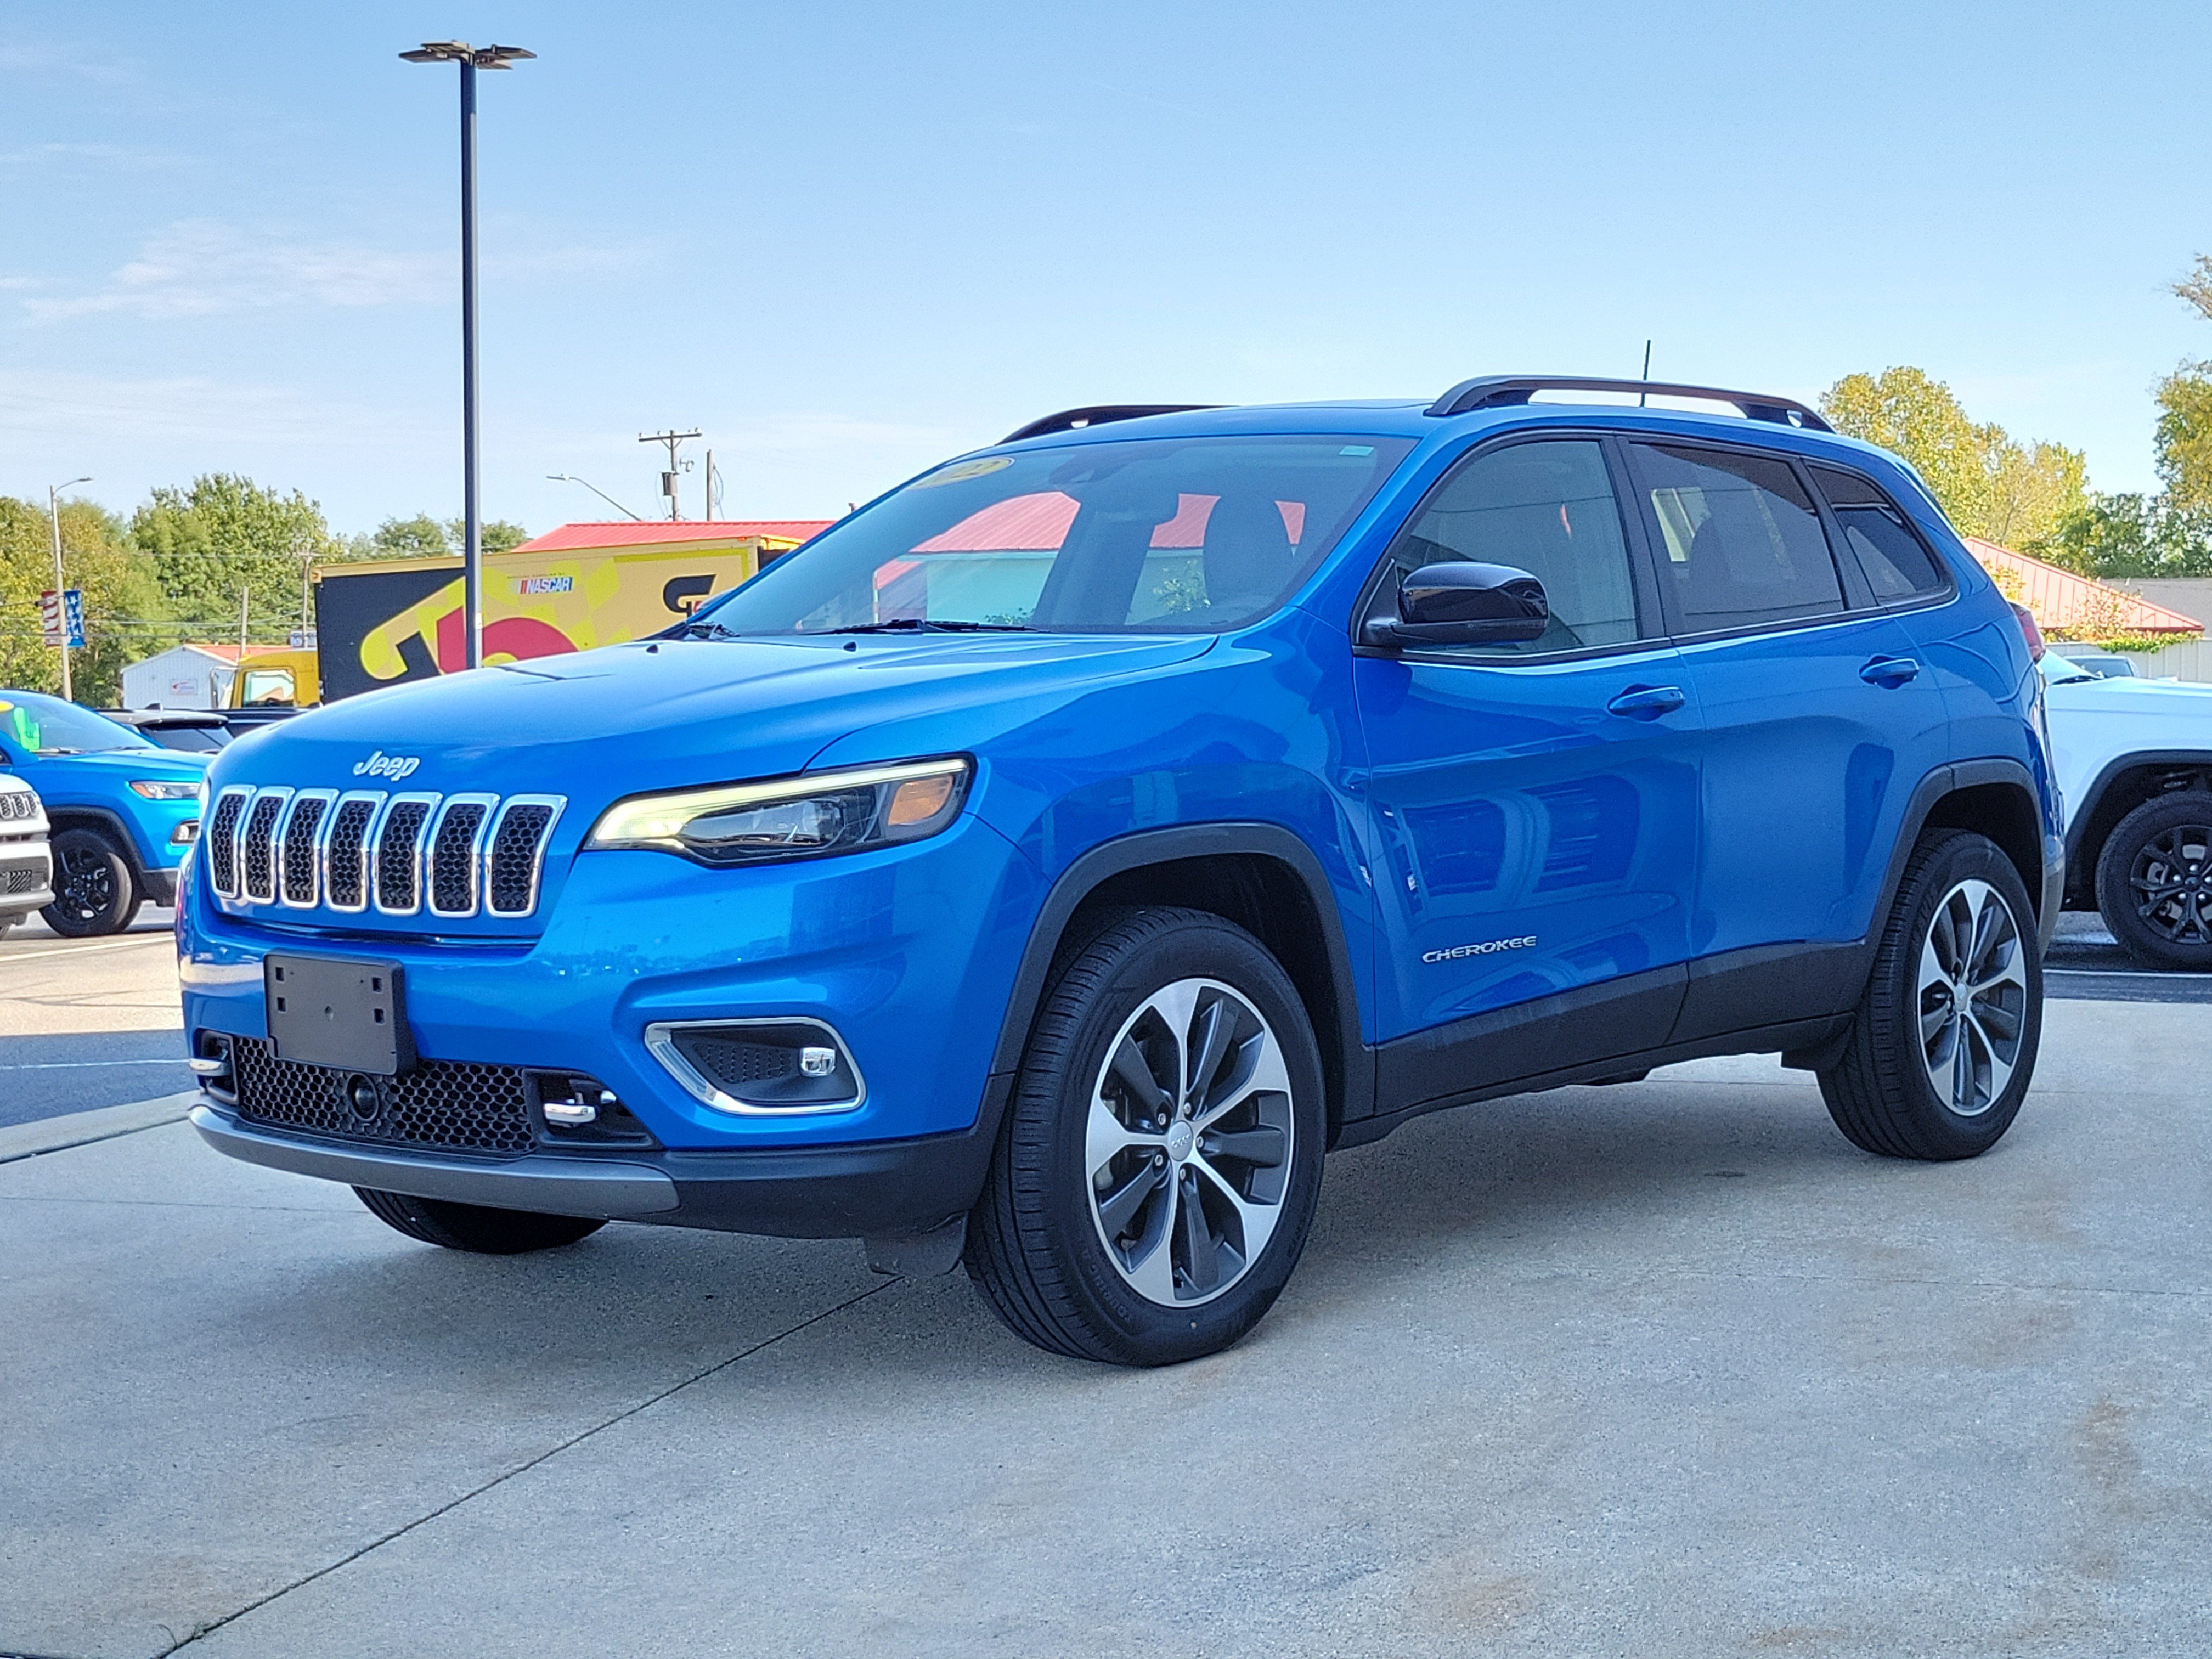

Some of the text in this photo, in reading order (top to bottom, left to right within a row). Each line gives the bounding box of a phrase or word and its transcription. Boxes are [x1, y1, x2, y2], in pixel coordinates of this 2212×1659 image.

[527, 577, 570, 594] NASCAR
[353, 750, 420, 782] Jeep
[1421, 935, 1537, 963] CHEROKEE
